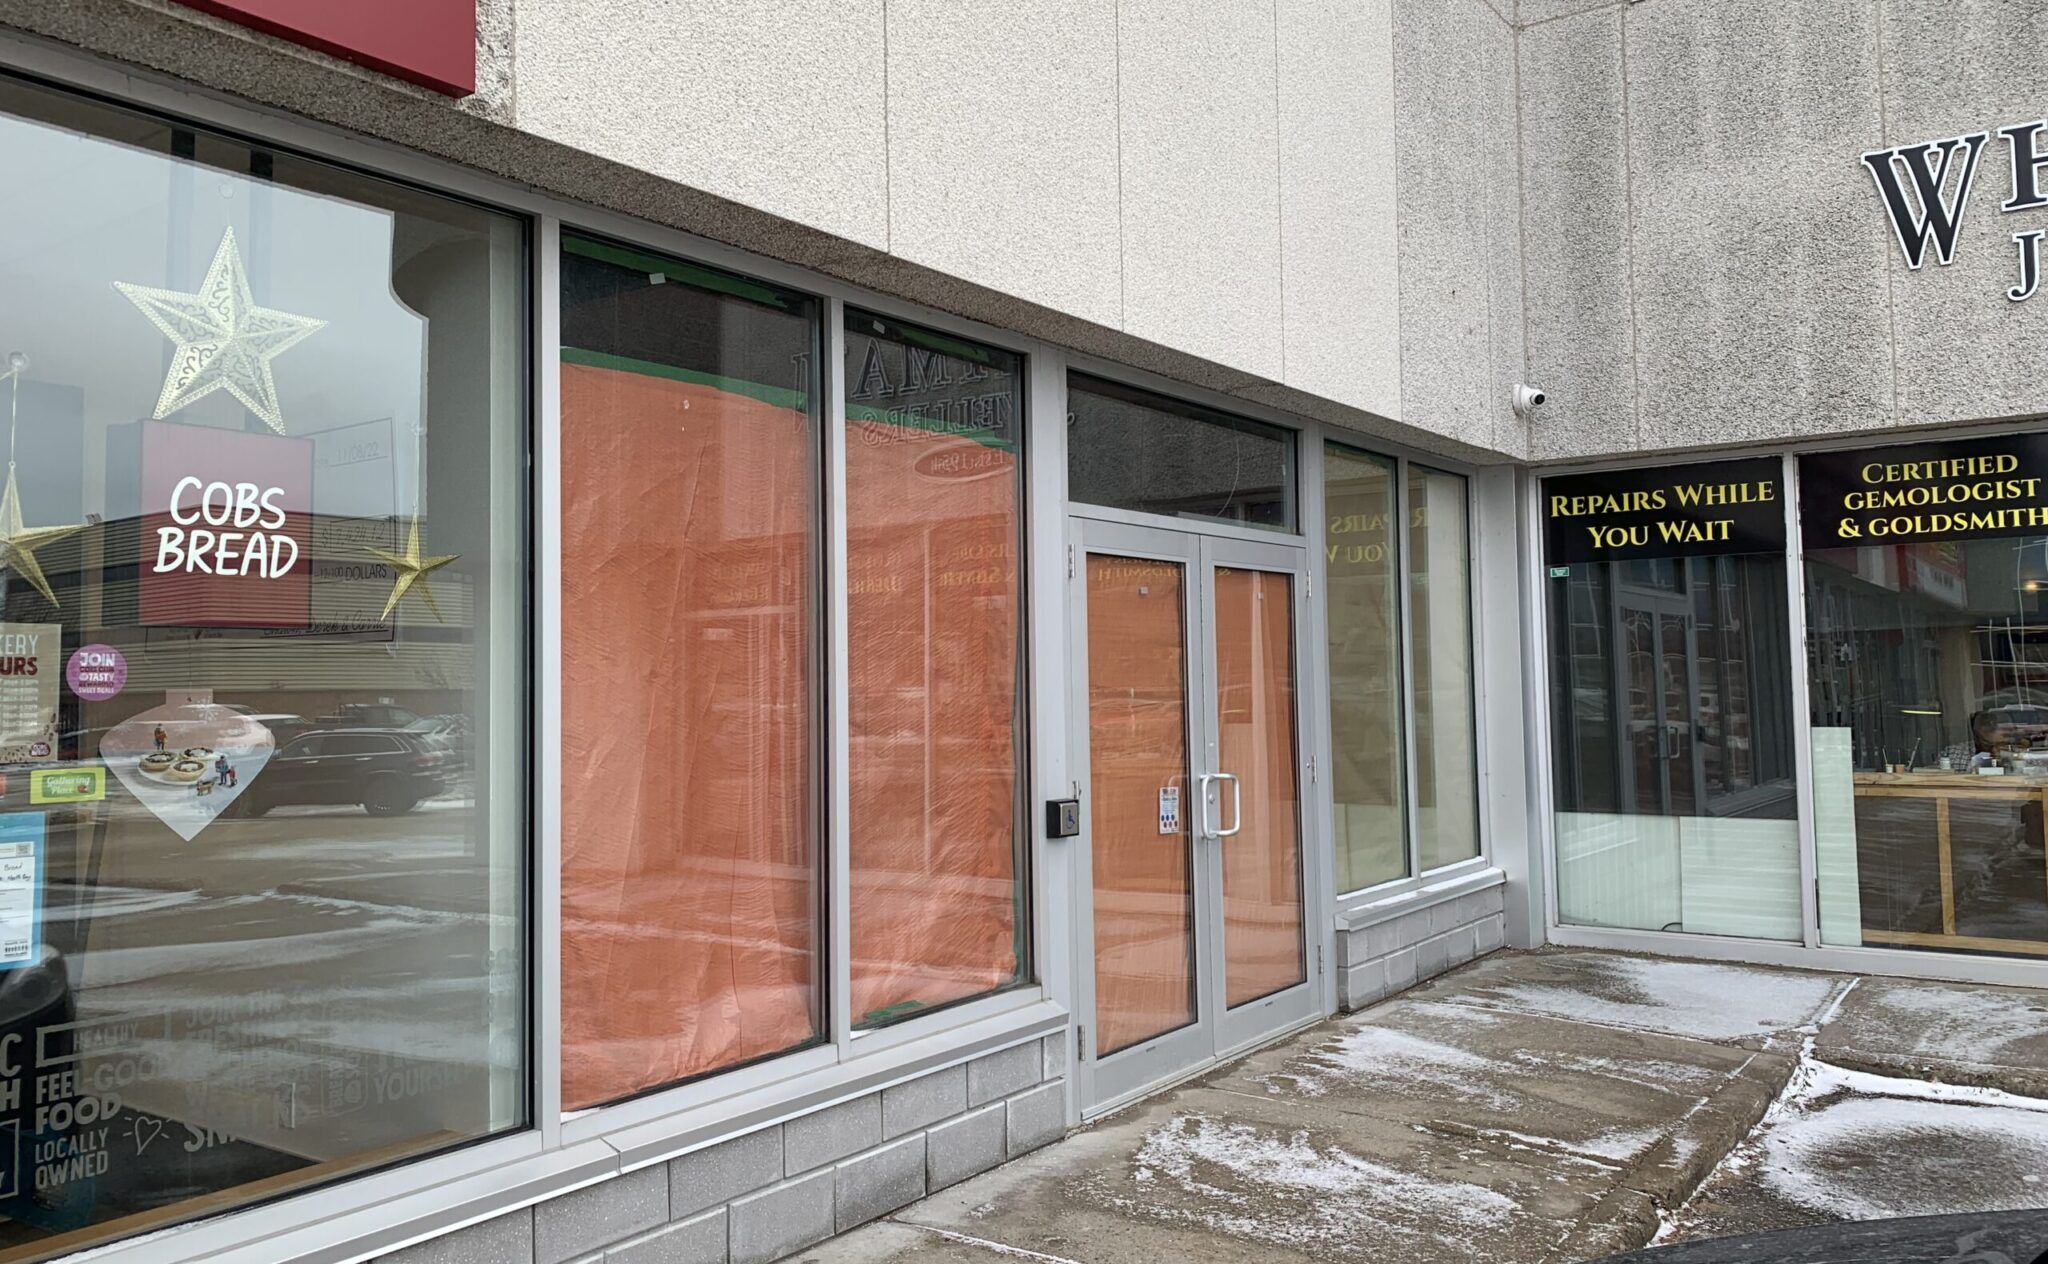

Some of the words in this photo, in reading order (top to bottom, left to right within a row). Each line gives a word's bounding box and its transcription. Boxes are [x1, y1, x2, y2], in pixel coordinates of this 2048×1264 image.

[2007, 228, 2046, 301] J
[1861, 454, 2020, 485] CERTIFIED
[169, 475, 287, 529] COBS
[1550, 489, 1667, 519] REPAIRS
[1673, 480, 1776, 507] WHILE
[1843, 477, 2042, 512] GEMOLOGIST
[1587, 525, 1650, 550] YOU
[1656, 519, 1736, 544] WAIT
[1837, 517, 1861, 540] &
[1868, 505, 2048, 538] GOLDSMITH
[152, 526, 299, 580] BREAD
[345, 563, 387, 581] DOLLARS
[80, 652, 116, 667] JOIN
[46, 776, 91, 788] Gathering
[73, 1021, 139, 1051] HEALTHY
[35, 1069, 83, 1104] FEEL
[35, 1092, 122, 1136] FOOD
[35, 1127, 109, 1164] LOCALLY
[35, 1151, 109, 1190] OWNED
